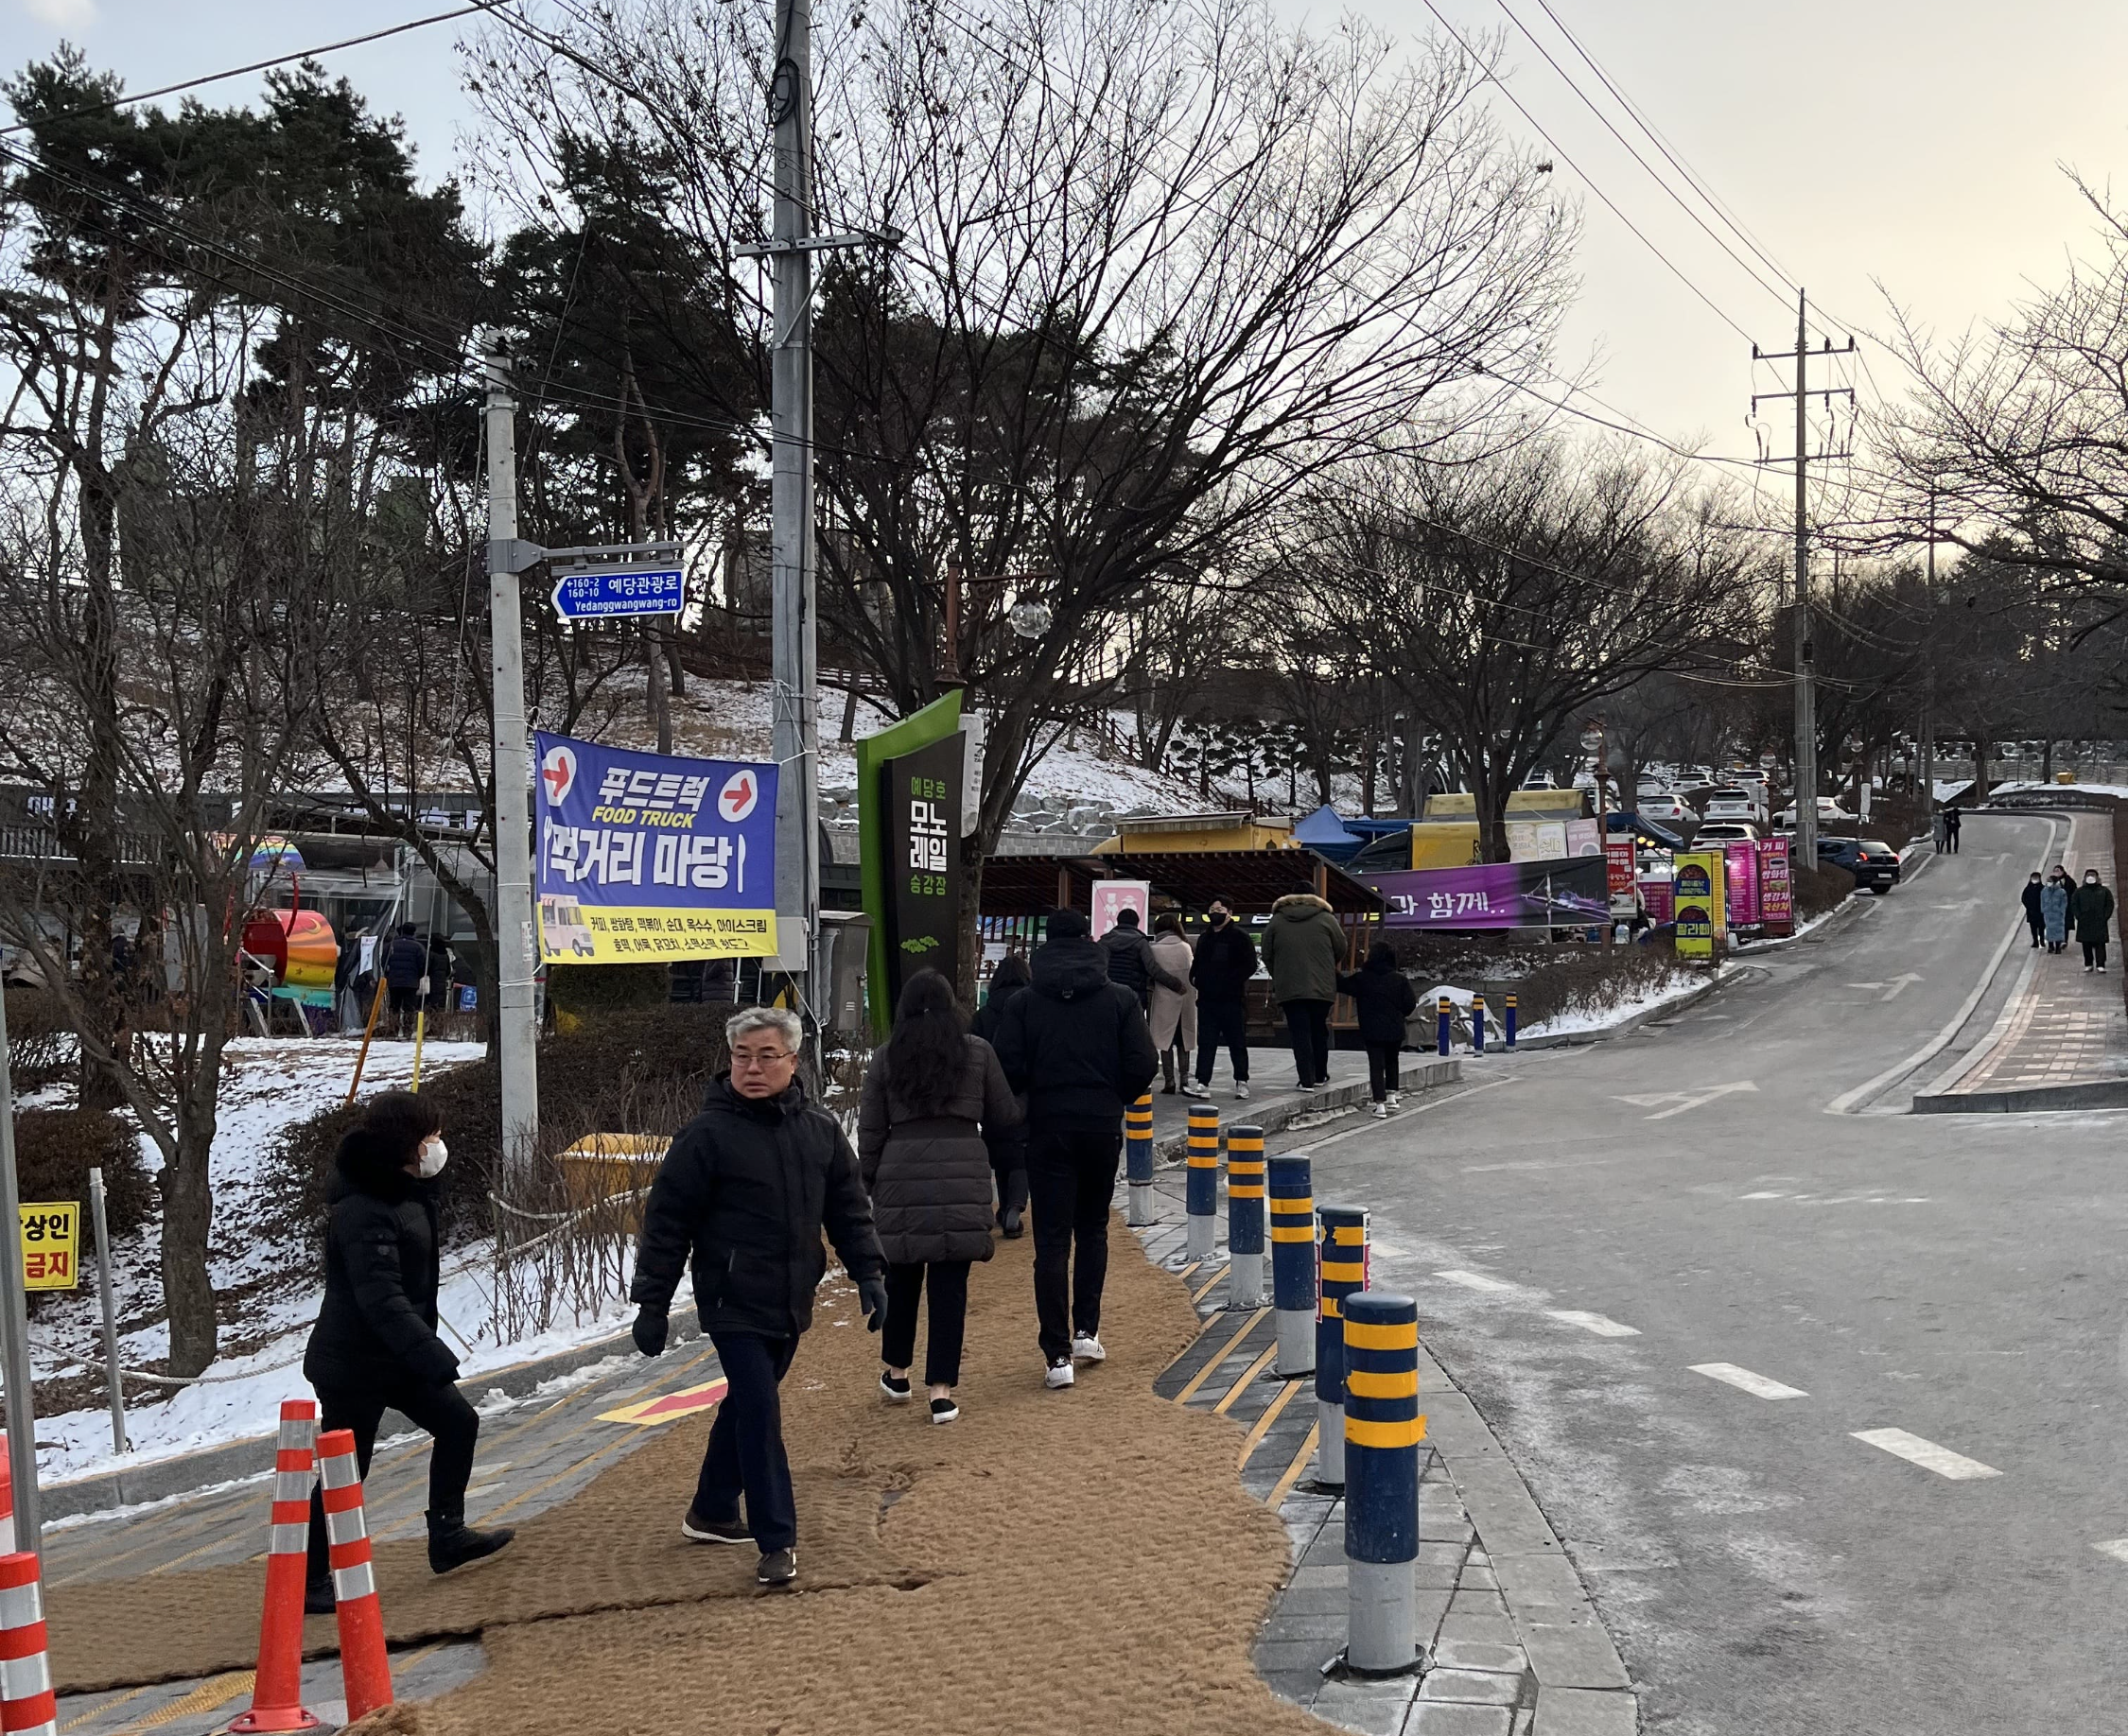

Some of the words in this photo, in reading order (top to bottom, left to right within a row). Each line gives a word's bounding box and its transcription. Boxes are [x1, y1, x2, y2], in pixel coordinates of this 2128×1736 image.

[568, 588, 600, 598] 160-10
[573, 579, 600, 587] 160-2
[608, 575, 678, 596] 예당관광로
[575, 598, 677, 613] Yedanggwangwang-ro
[599, 767, 710, 811] 푸드트럭
[911, 776, 946, 800] 예당호
[591, 807, 637, 825] FOOD
[639, 810, 697, 829] TRUCK
[910, 801, 947, 836] 모노
[550, 825, 646, 885] 먹거리
[654, 834, 733, 889] 마당
[910, 836, 947, 872] 레일
[910, 874, 946, 896] 승강장
[1763, 893, 1788, 901] 생강차
[717, 919, 767, 932] 아이스크림
[20, 1214, 69, 1241] 상인
[26, 1251, 68, 1278] 금지
